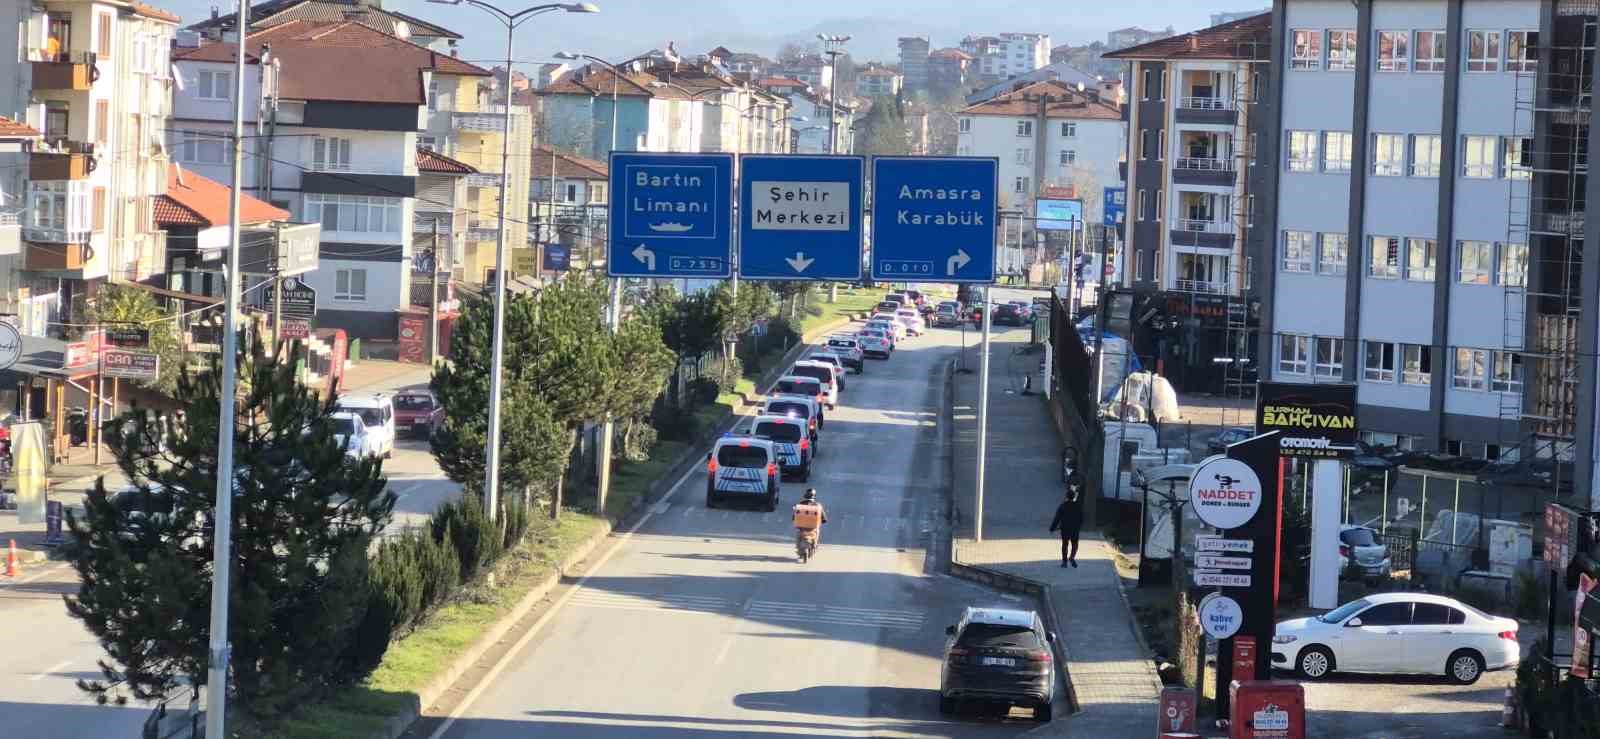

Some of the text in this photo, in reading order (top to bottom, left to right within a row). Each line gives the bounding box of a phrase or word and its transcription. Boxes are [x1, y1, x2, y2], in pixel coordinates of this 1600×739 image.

[636, 171, 701, 187] Bartın
[769, 187, 830, 203] Şehir
[898, 184, 981, 200] Amasra
[633, 196, 708, 213] Limanı
[756, 209, 845, 225] Merkezi
[897, 209, 984, 226] Karabük
[1197, 489, 1257, 501] NADDET
